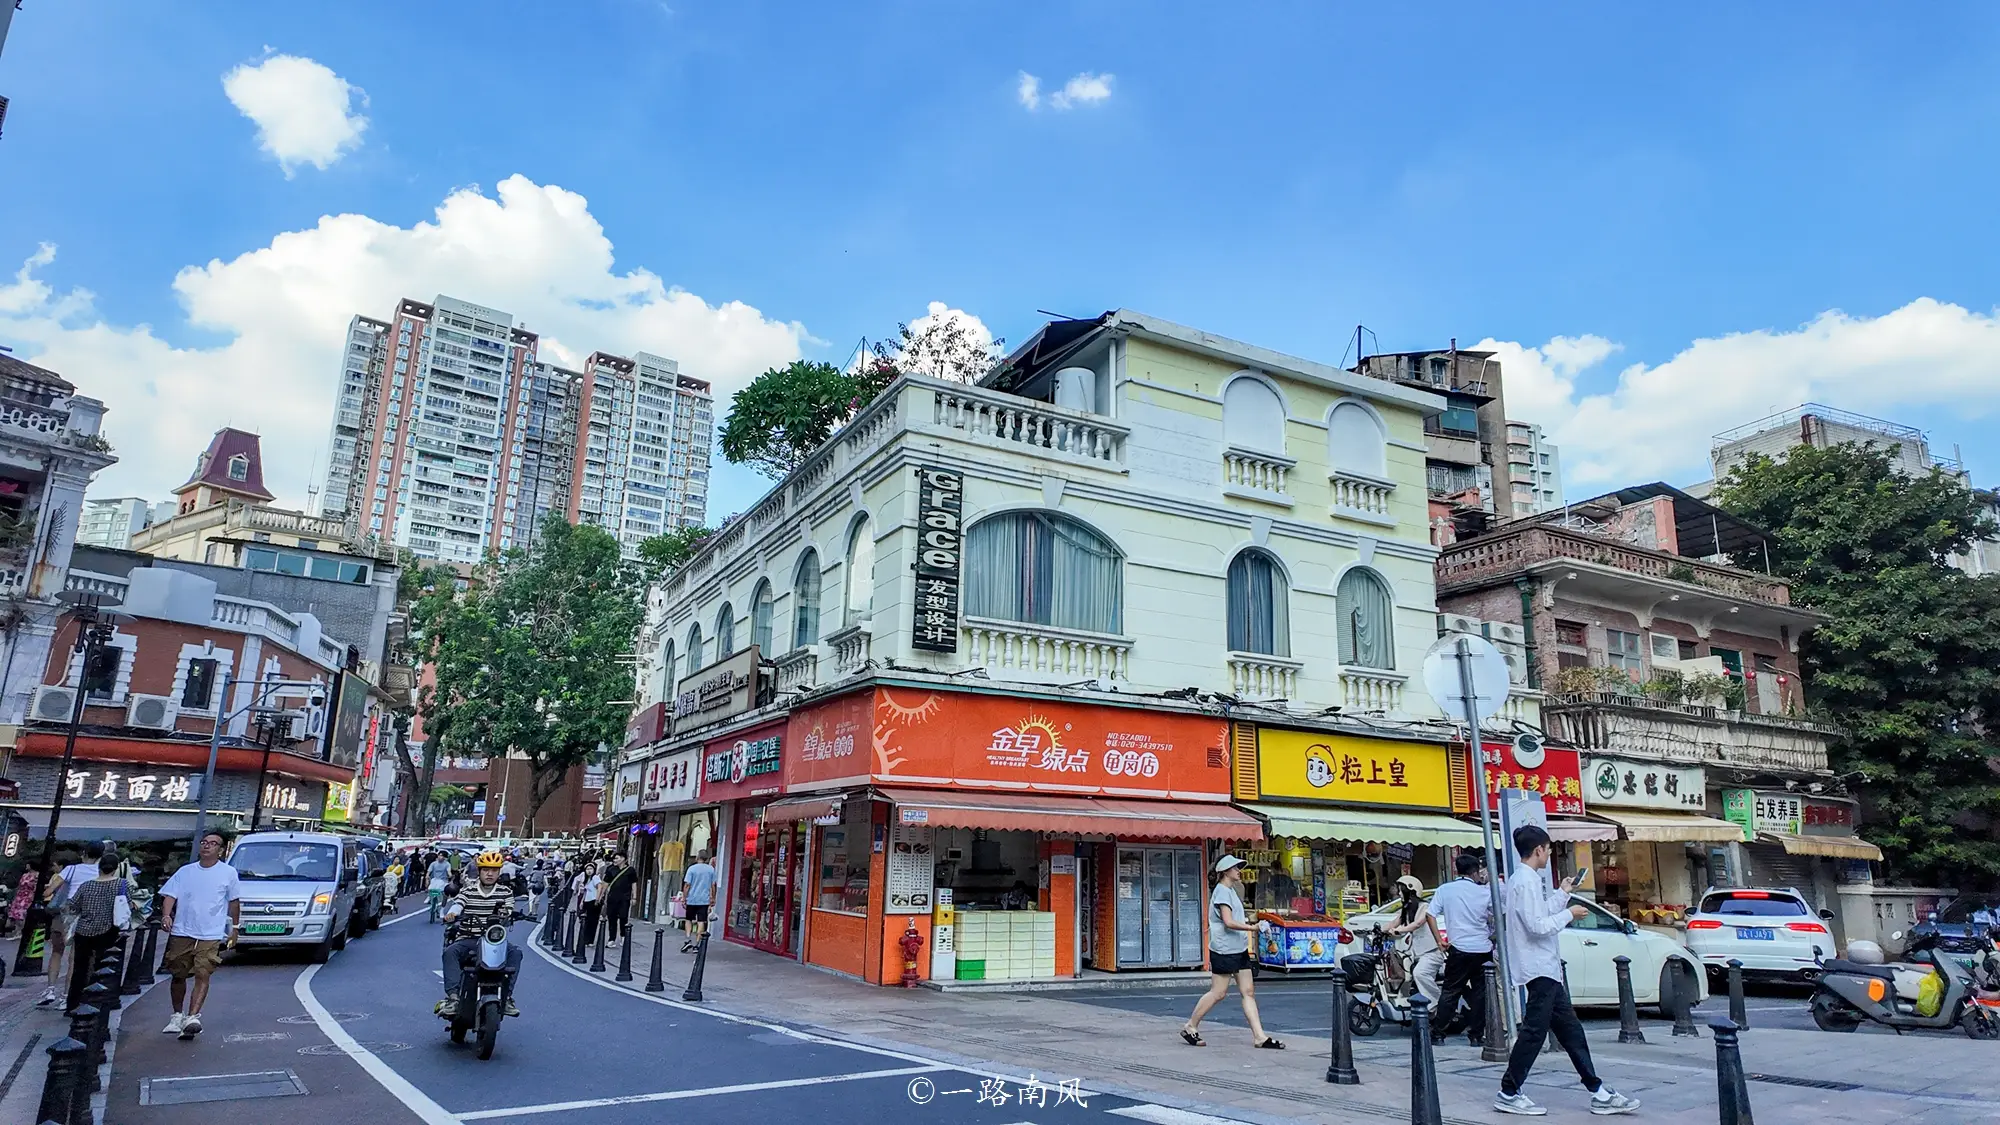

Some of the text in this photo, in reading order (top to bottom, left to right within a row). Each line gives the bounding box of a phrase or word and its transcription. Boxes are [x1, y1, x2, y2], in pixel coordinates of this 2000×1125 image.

[922, 471, 960, 569] Grace
[924, 579, 949, 642] 发型设计
[705, 750, 732, 782] 塔斯汀
[1104, 750, 1158, 776] 龟岗店
[1340, 753, 1409, 788] 粒上皇
[1756, 798, 1799, 821] 白发养黑
